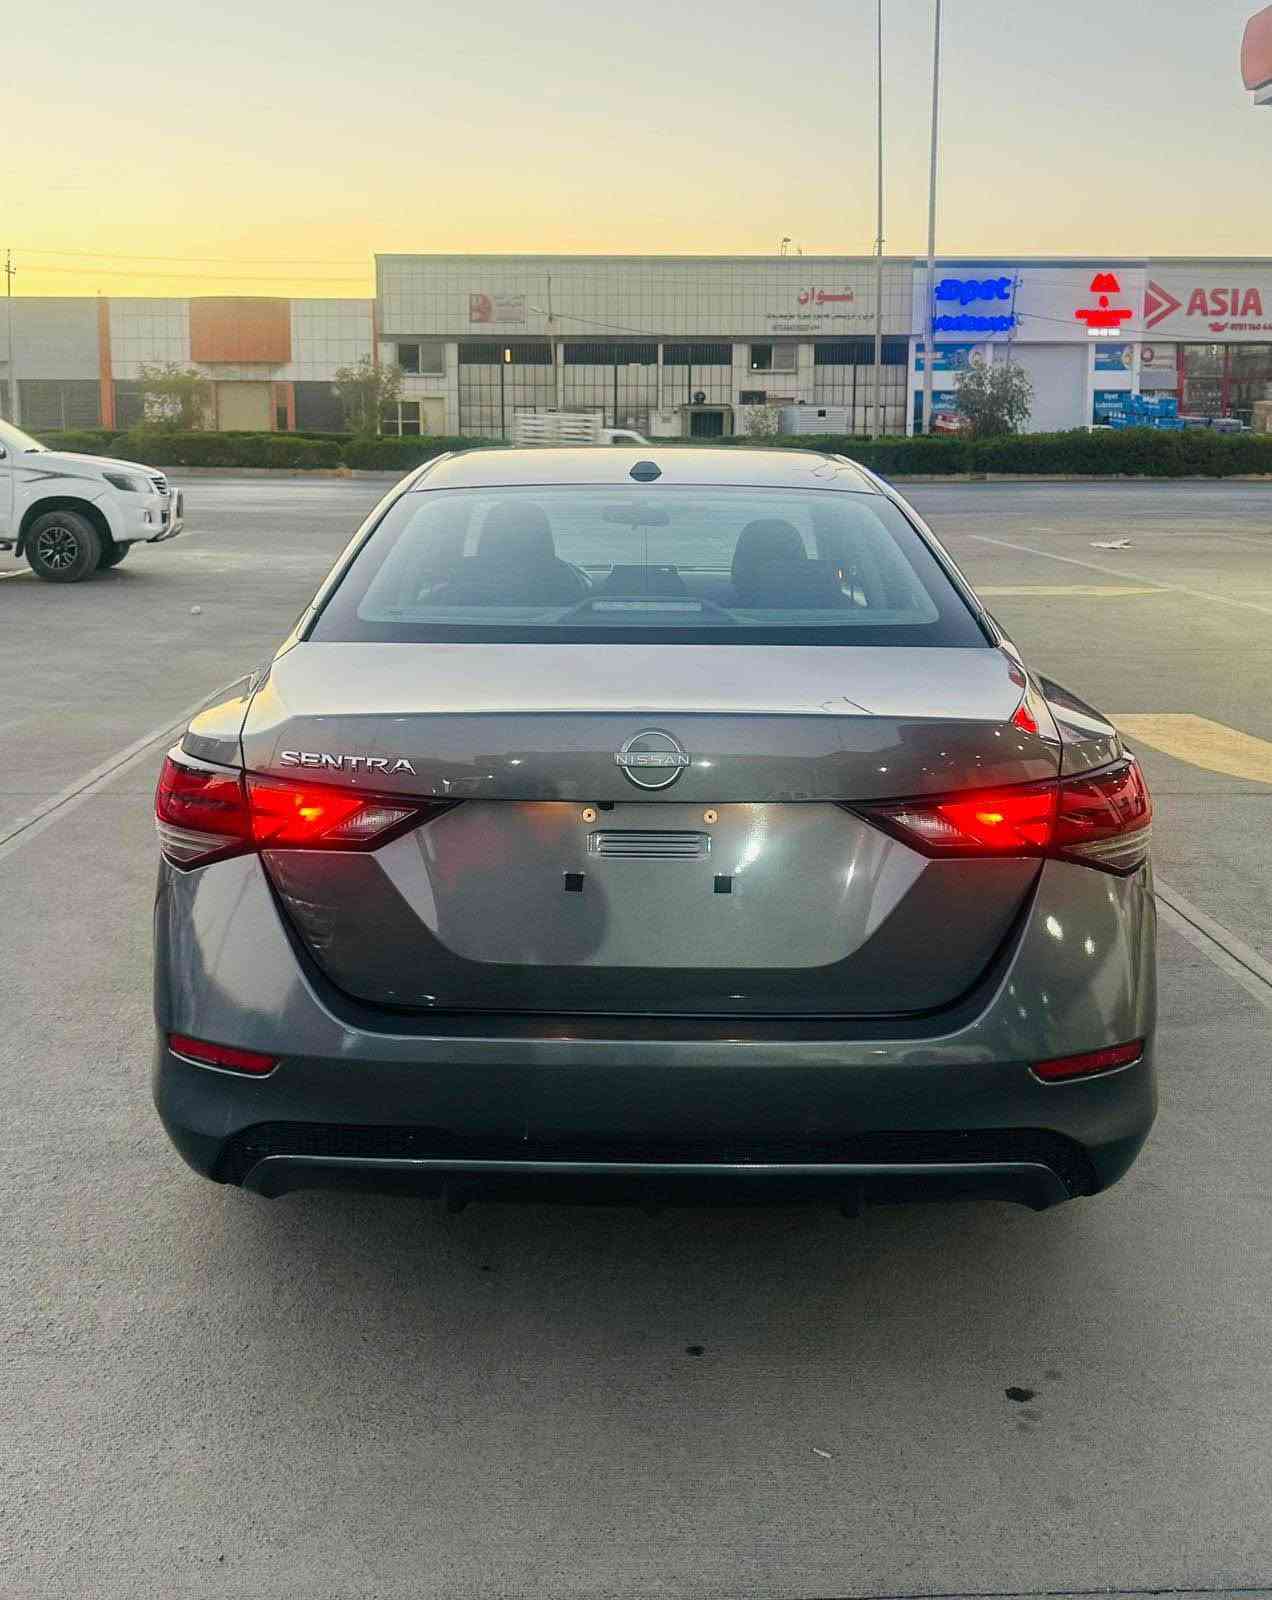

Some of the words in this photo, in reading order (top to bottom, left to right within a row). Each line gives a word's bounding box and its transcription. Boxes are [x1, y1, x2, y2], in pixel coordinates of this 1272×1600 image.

[1185, 288, 1263, 316] ASIA
[279, 750, 416, 777] SENTRA
[615, 753, 689, 767] NISSAN
